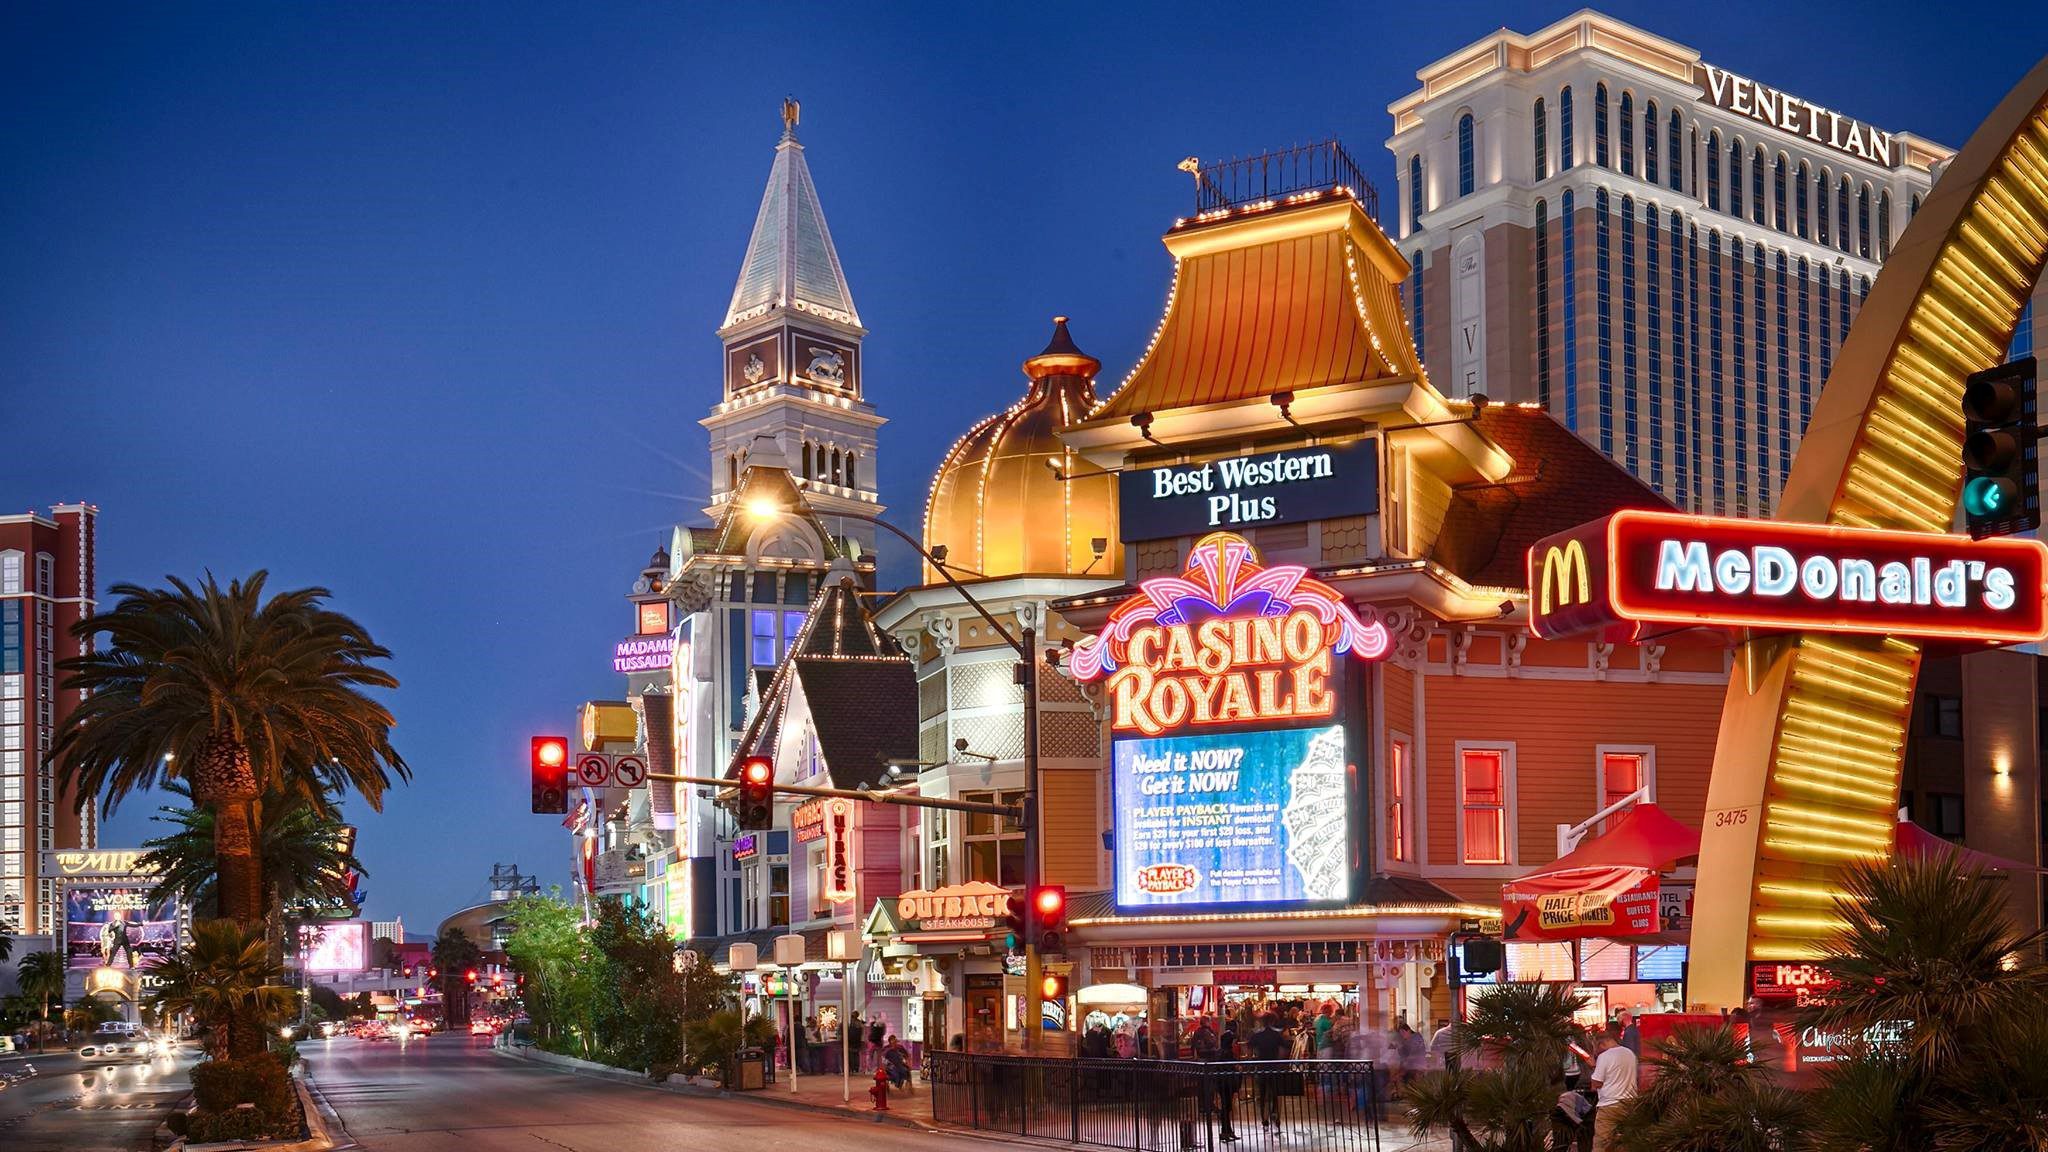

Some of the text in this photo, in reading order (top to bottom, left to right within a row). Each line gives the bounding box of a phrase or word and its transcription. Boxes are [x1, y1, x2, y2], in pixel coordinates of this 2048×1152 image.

[1702, 62, 1893, 167] VENETIAN
[1153, 453, 1333, 498] Best Western
[1208, 493, 1276, 526] Plus
[1654, 538, 2016, 611] McDonald's
[1128, 611, 1323, 676] CASINO
[1110, 647, 1334, 736] ROYALE
[1131, 747, 1244, 775] Need it NOW?
[1141, 770, 1240, 796] Get it NOW!
[1133, 806, 1175, 818] PLAYER
[1176, 803, 1229, 817] PAYBACK
[1715, 809, 1748, 827] 3475
[1182, 814, 1233, 827] INSTANT
[1254, 824, 1271, 835] and
[1162, 840, 1185, 851] every
[55, 853, 84, 865] THE
[1147, 867, 1185, 880] PLAYER
[1147, 879, 1185, 890] PAYBACK
[104, 893, 143, 904] VOICE
[1544, 896, 1575, 911] HALF
[1616, 891, 1658, 903] RESTAURANTS
[898, 894, 1012, 919] OUTBACK
[926, 918, 989, 929] STEAKHOUSE
[1542, 909, 1575, 924] PRICE
